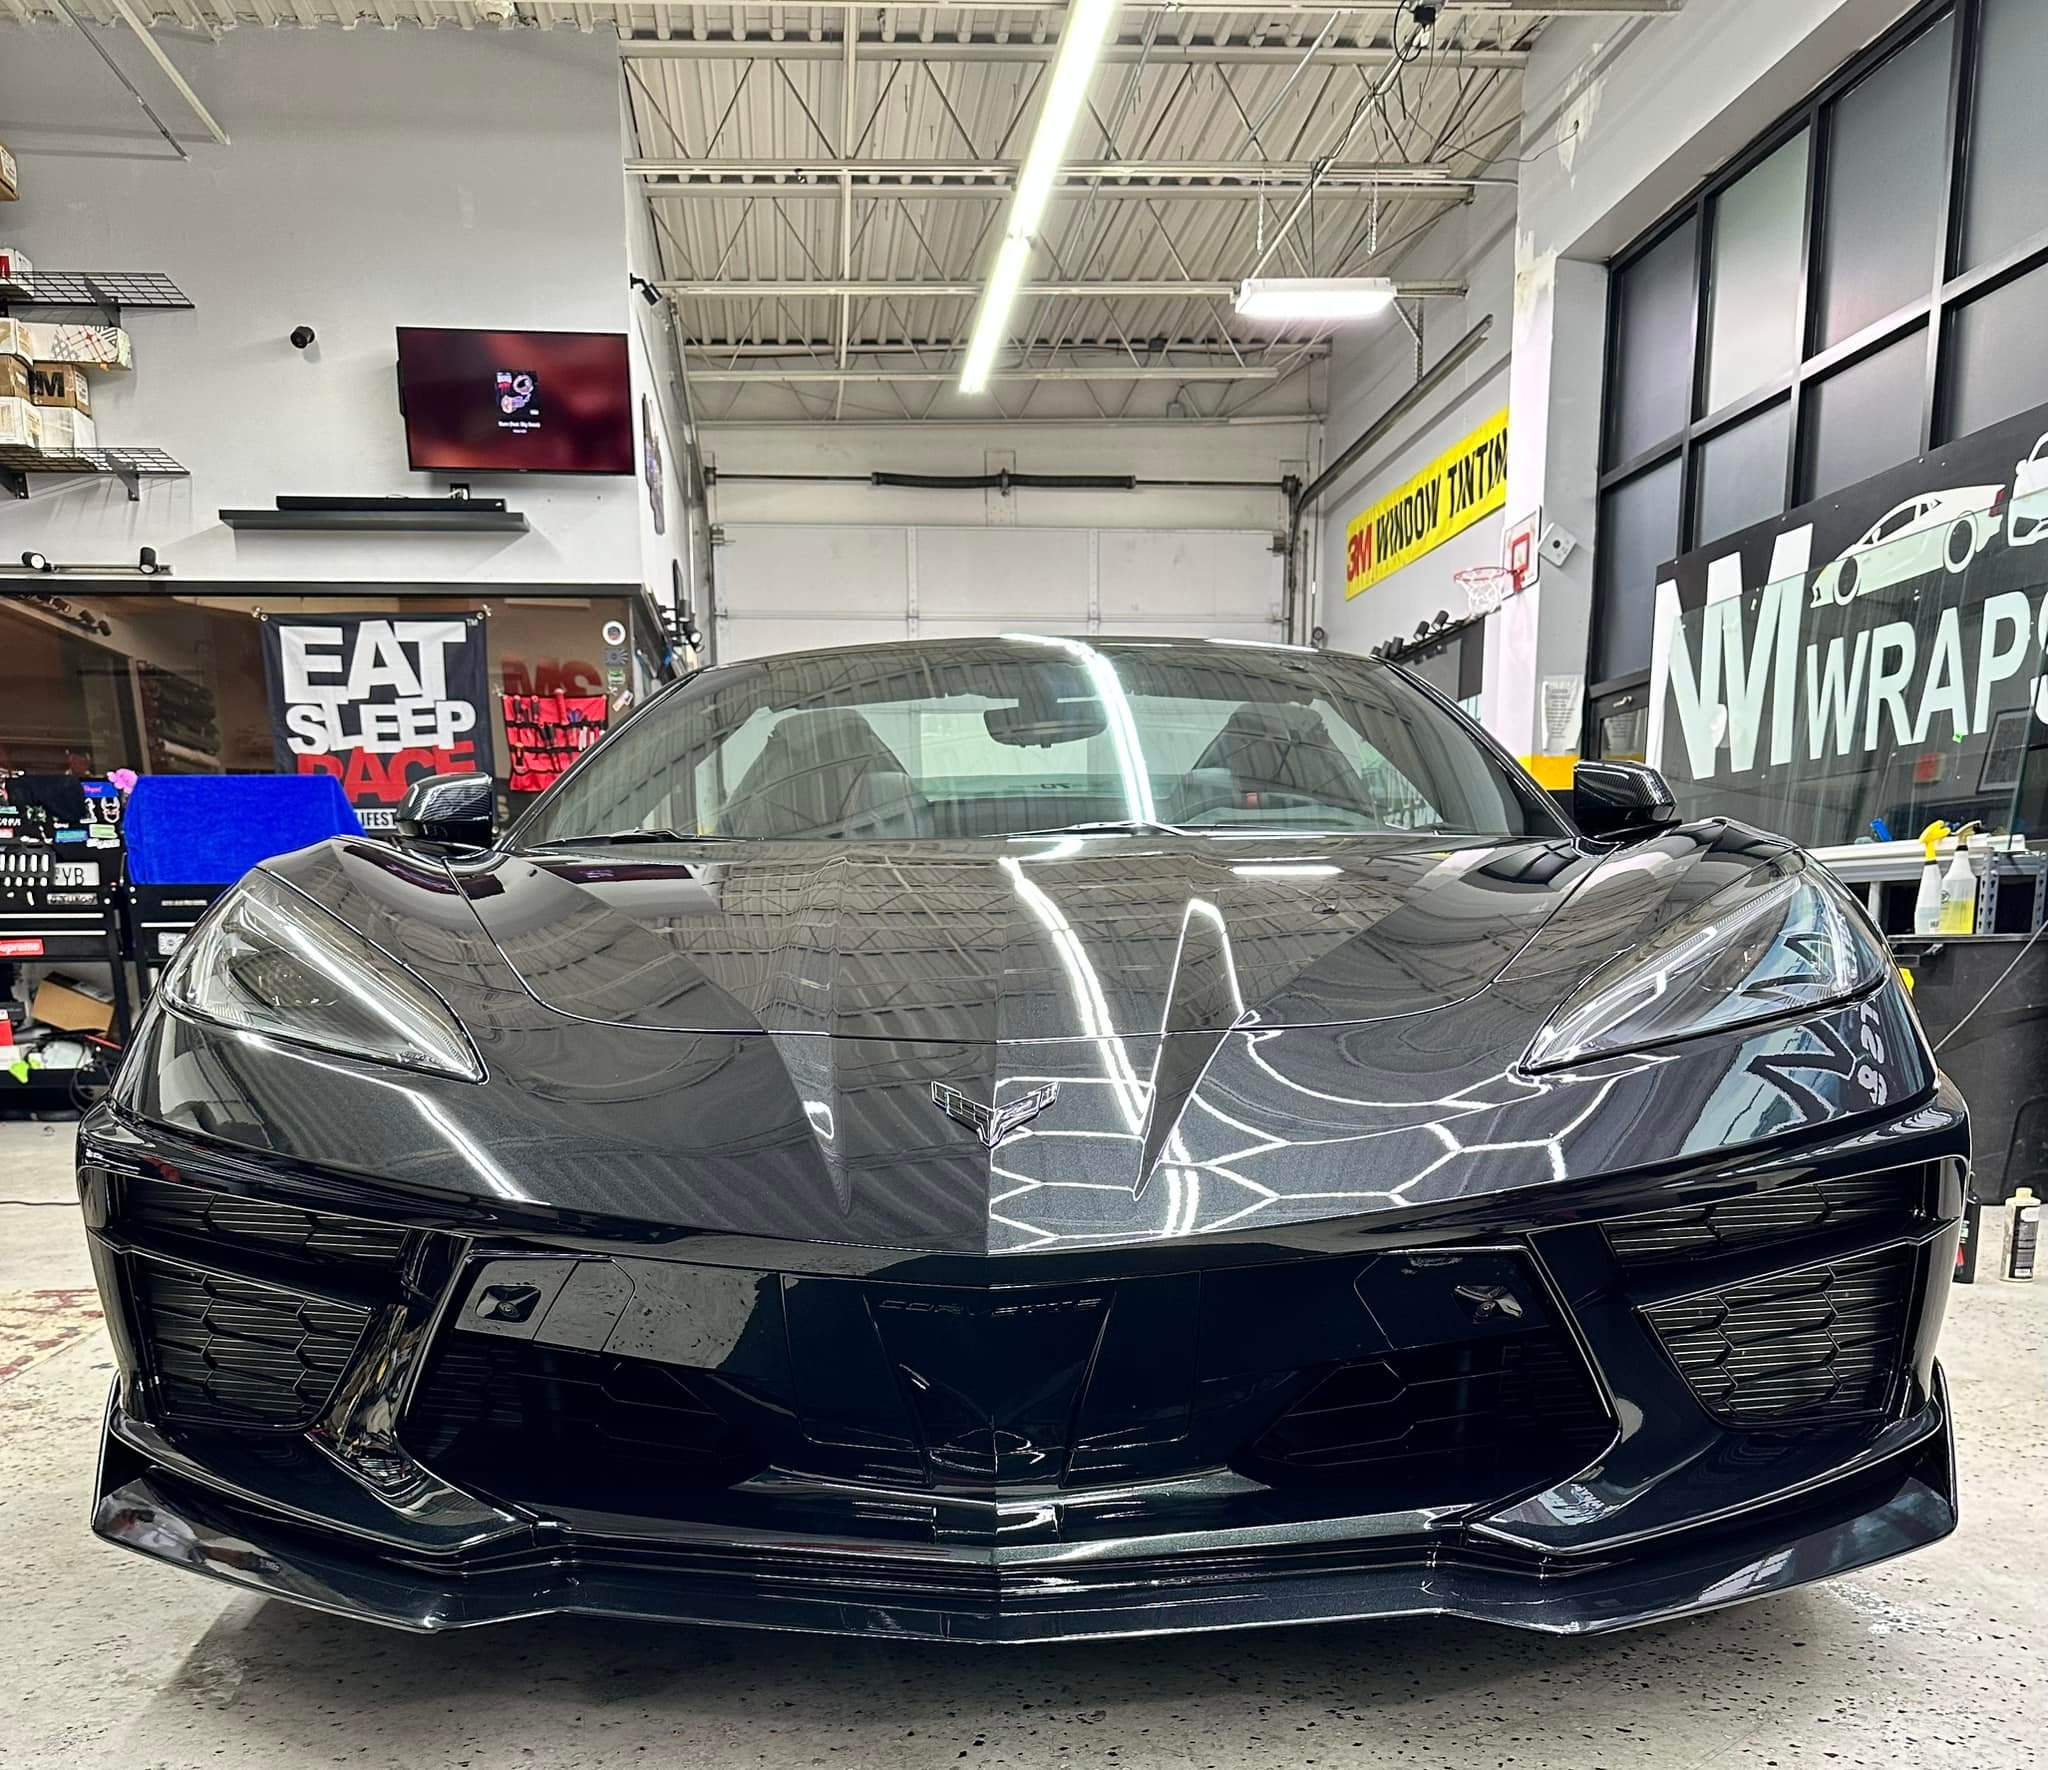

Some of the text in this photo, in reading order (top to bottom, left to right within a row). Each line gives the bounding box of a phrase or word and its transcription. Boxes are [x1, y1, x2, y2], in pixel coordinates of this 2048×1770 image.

[30, 370, 65, 398] M
[1347, 428, 1508, 582] 3M WINDOW TINTIN
[279, 619, 467, 705] EAT
[285, 698, 477, 755] SLEEP
[360, 811, 397, 826] IFEST
